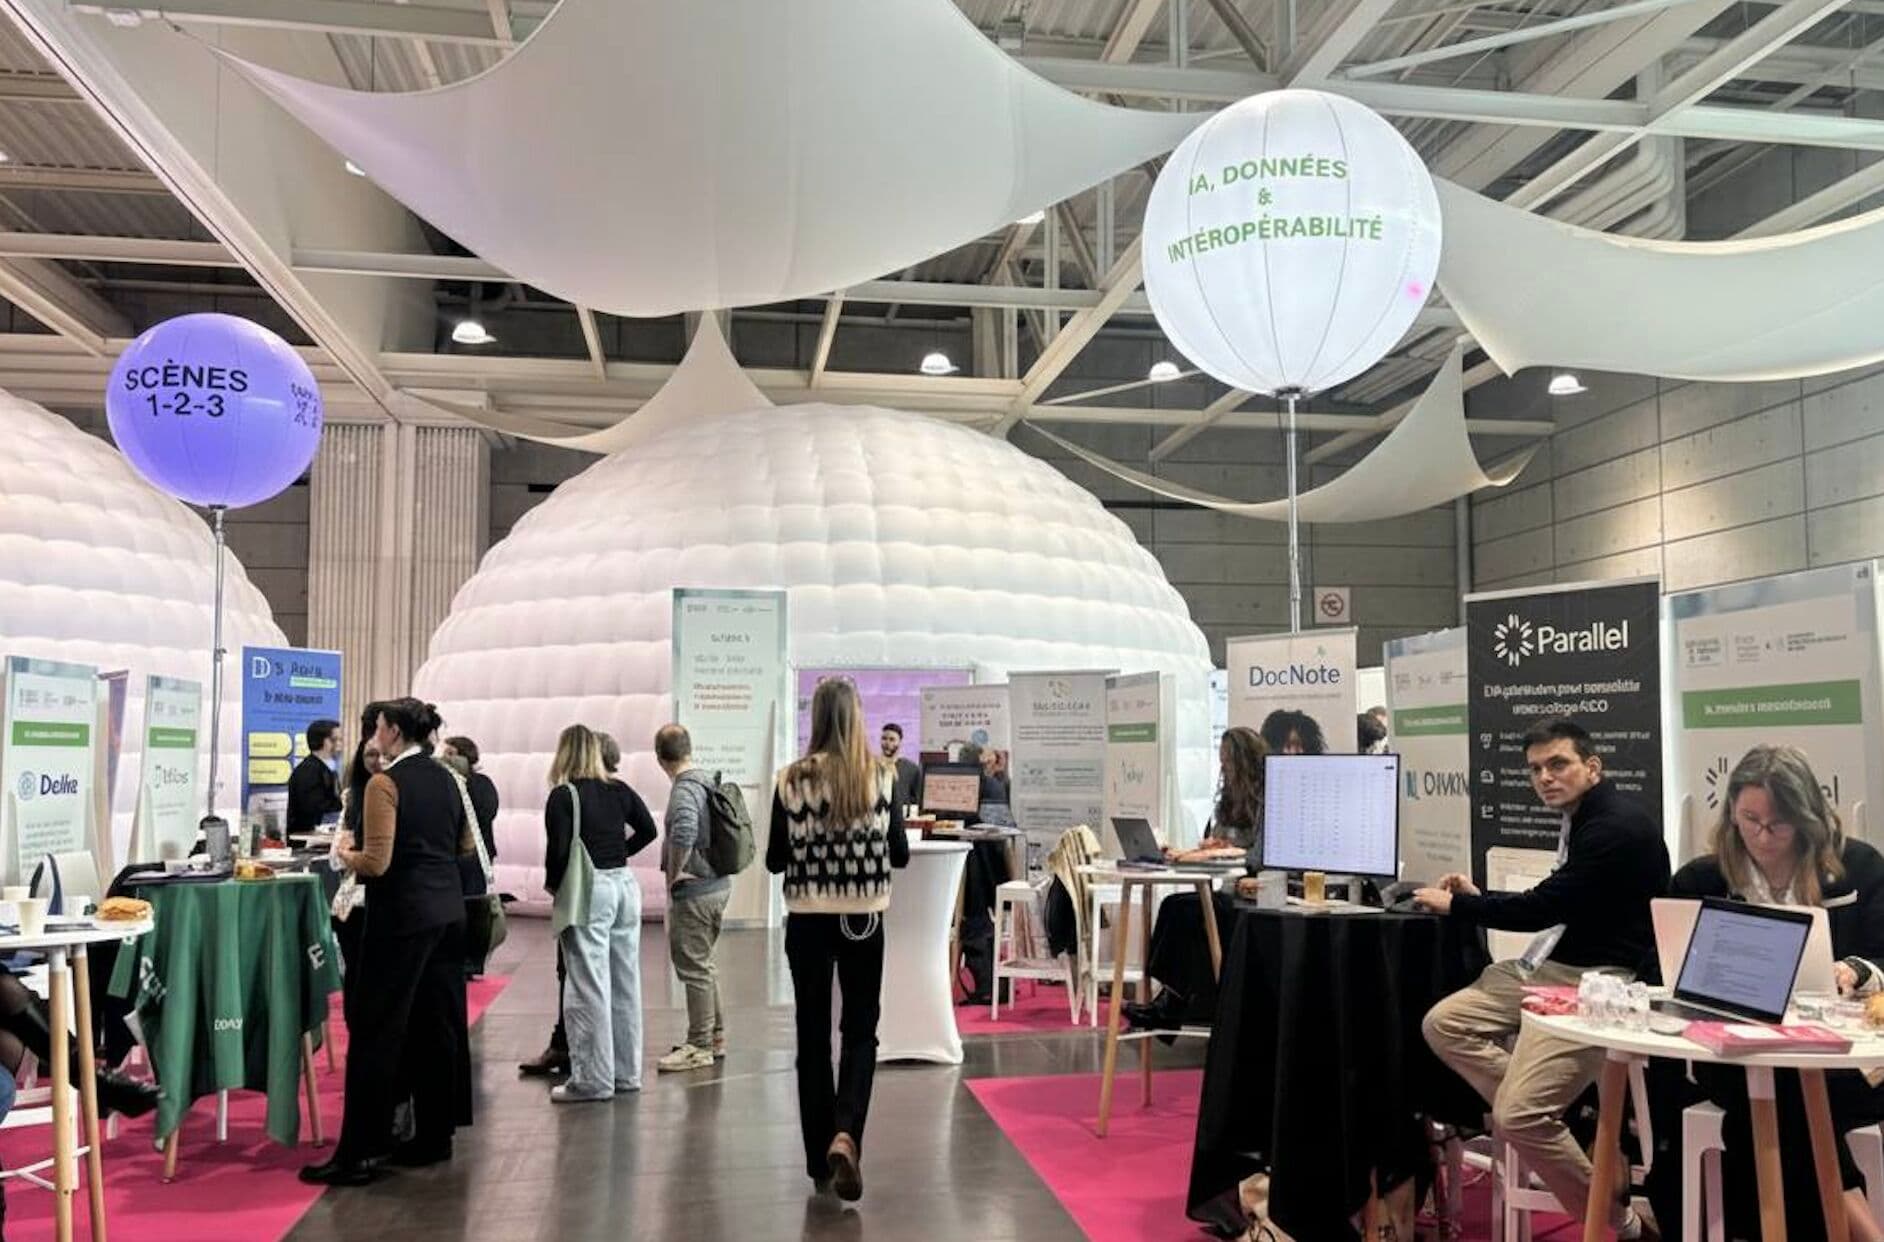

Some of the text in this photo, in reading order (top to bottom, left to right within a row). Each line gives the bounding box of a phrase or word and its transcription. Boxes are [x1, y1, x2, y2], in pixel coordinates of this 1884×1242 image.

[1188, 153, 1348, 196] IA, DONNÉES
[1258, 187, 1273, 206] &
[1167, 213, 1384, 264] INTÉROPÉRABILITÉ
[125, 358, 249, 393] SCÈNES
[146, 391, 225, 417] 1-2-3
[1537, 619, 1629, 655] Parallel
[1249, 663, 1341, 687] DocNote
